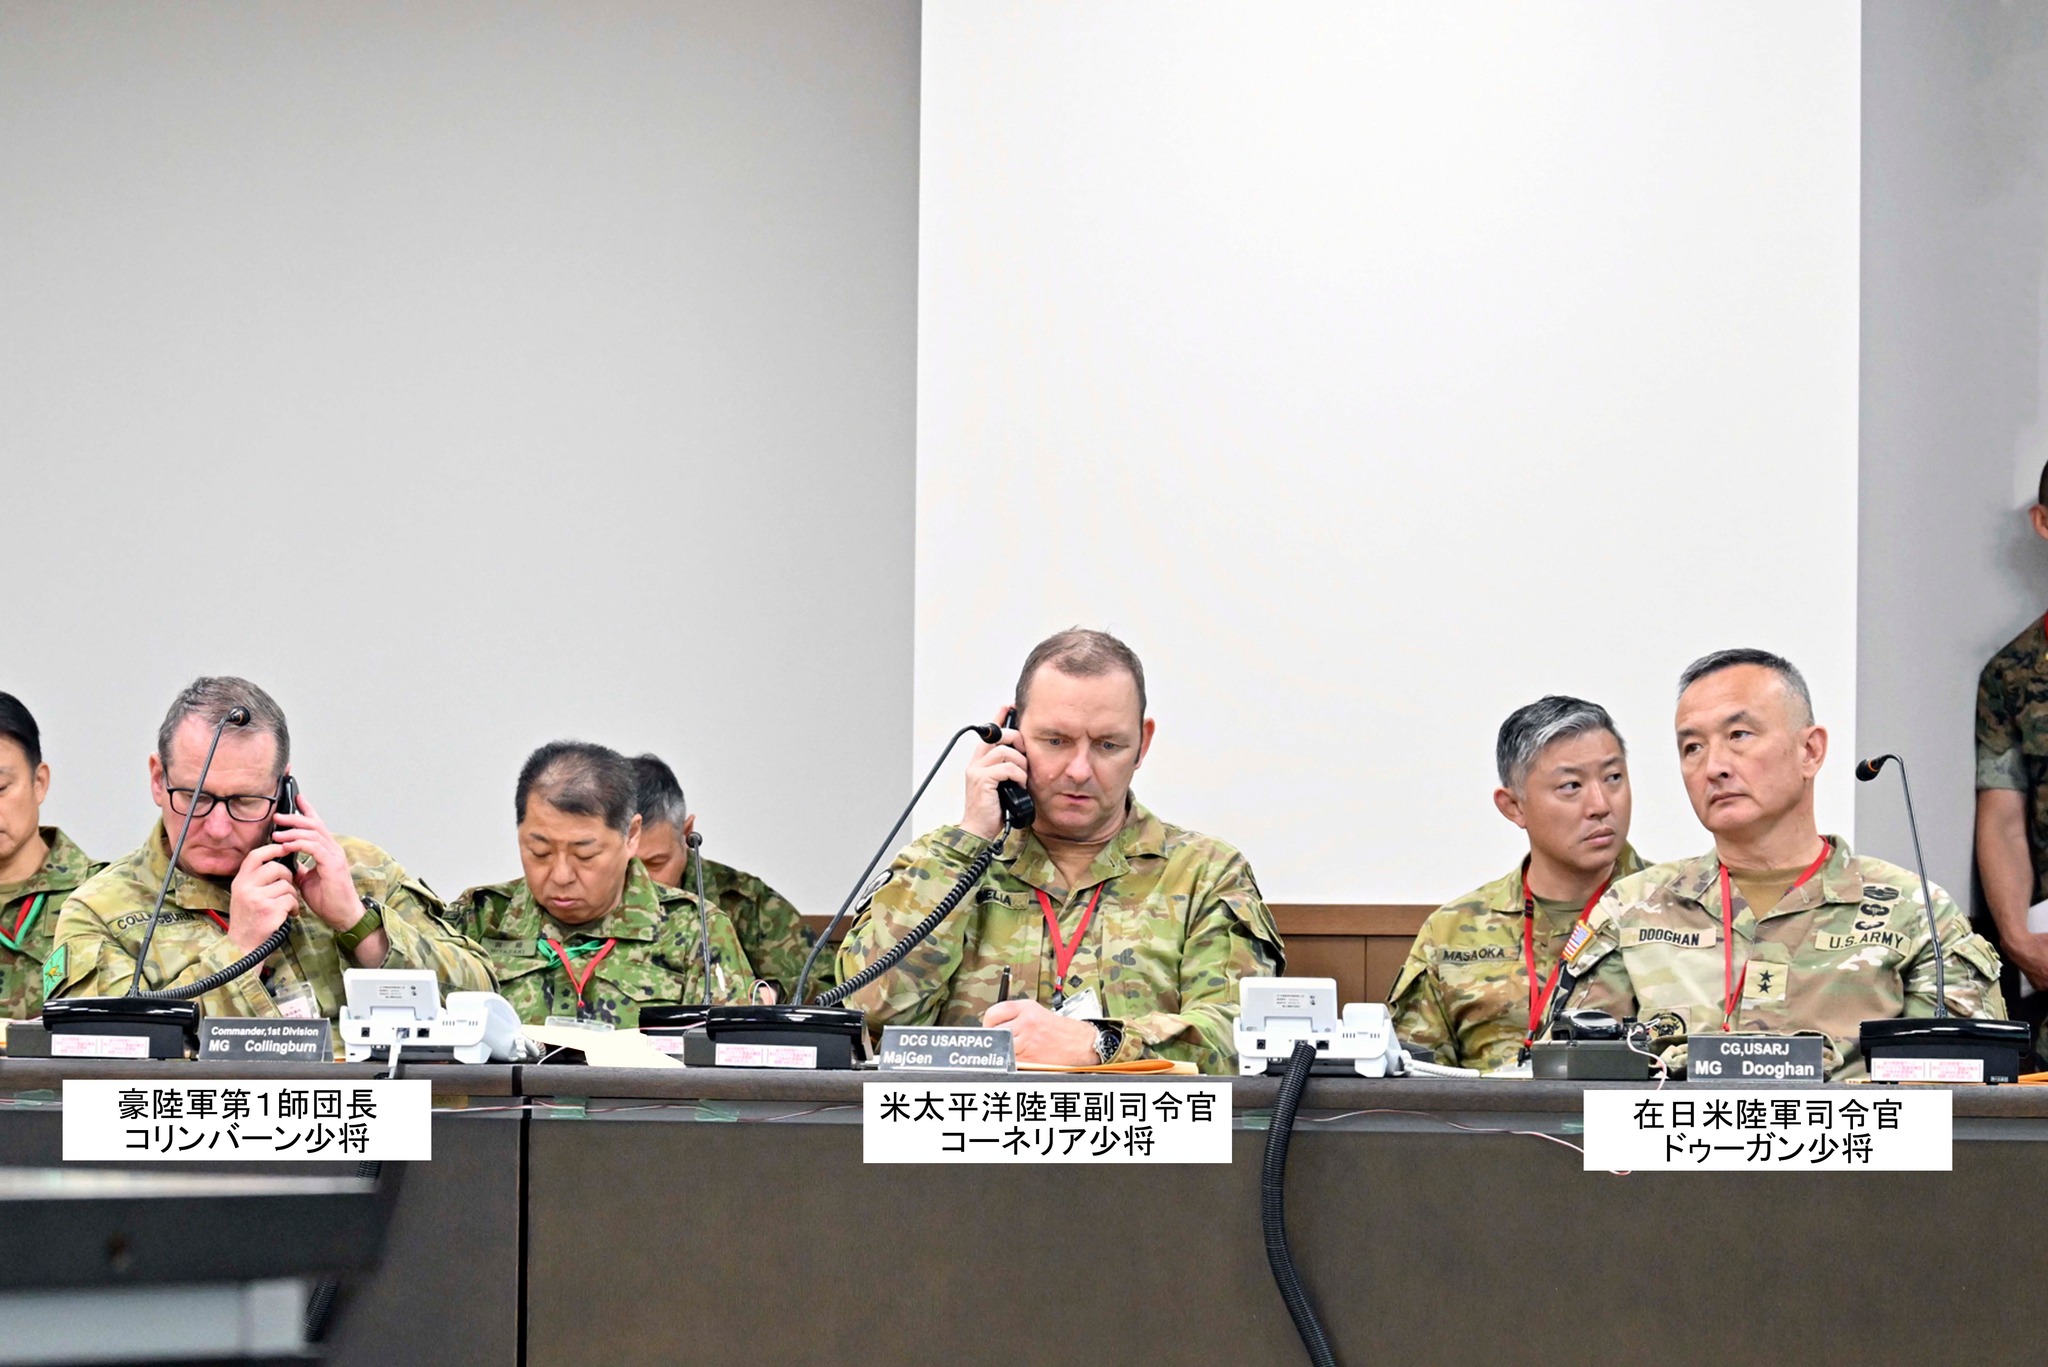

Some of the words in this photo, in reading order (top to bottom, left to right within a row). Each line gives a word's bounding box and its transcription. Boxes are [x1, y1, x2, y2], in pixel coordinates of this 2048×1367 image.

[117, 909, 195, 930] COLLGBURN
[1639, 928, 1700, 946] DOOGHAN
[1829, 935, 1857, 949] U.S.
[1859, 931, 1904, 949] ARMY
[1443, 947, 1505, 961] MASAOKA
[211, 1026, 280, 1037] Commander,1st
[283, 1026, 319, 1037] Division
[208, 1040, 230, 1052] MG
[245, 1040, 317, 1055] Collingburn
[899, 1034, 928, 1046] DCG
[931, 1035, 993, 1048] USARPAC
[1720, 1042, 1790, 1057] CG,USARJ
[883, 1051, 933, 1066] MajGen
[949, 1052, 1004, 1066] Cornelia
[1695, 1060, 1722, 1075] MG
[1742, 1060, 1815, 1079] Dooghan
